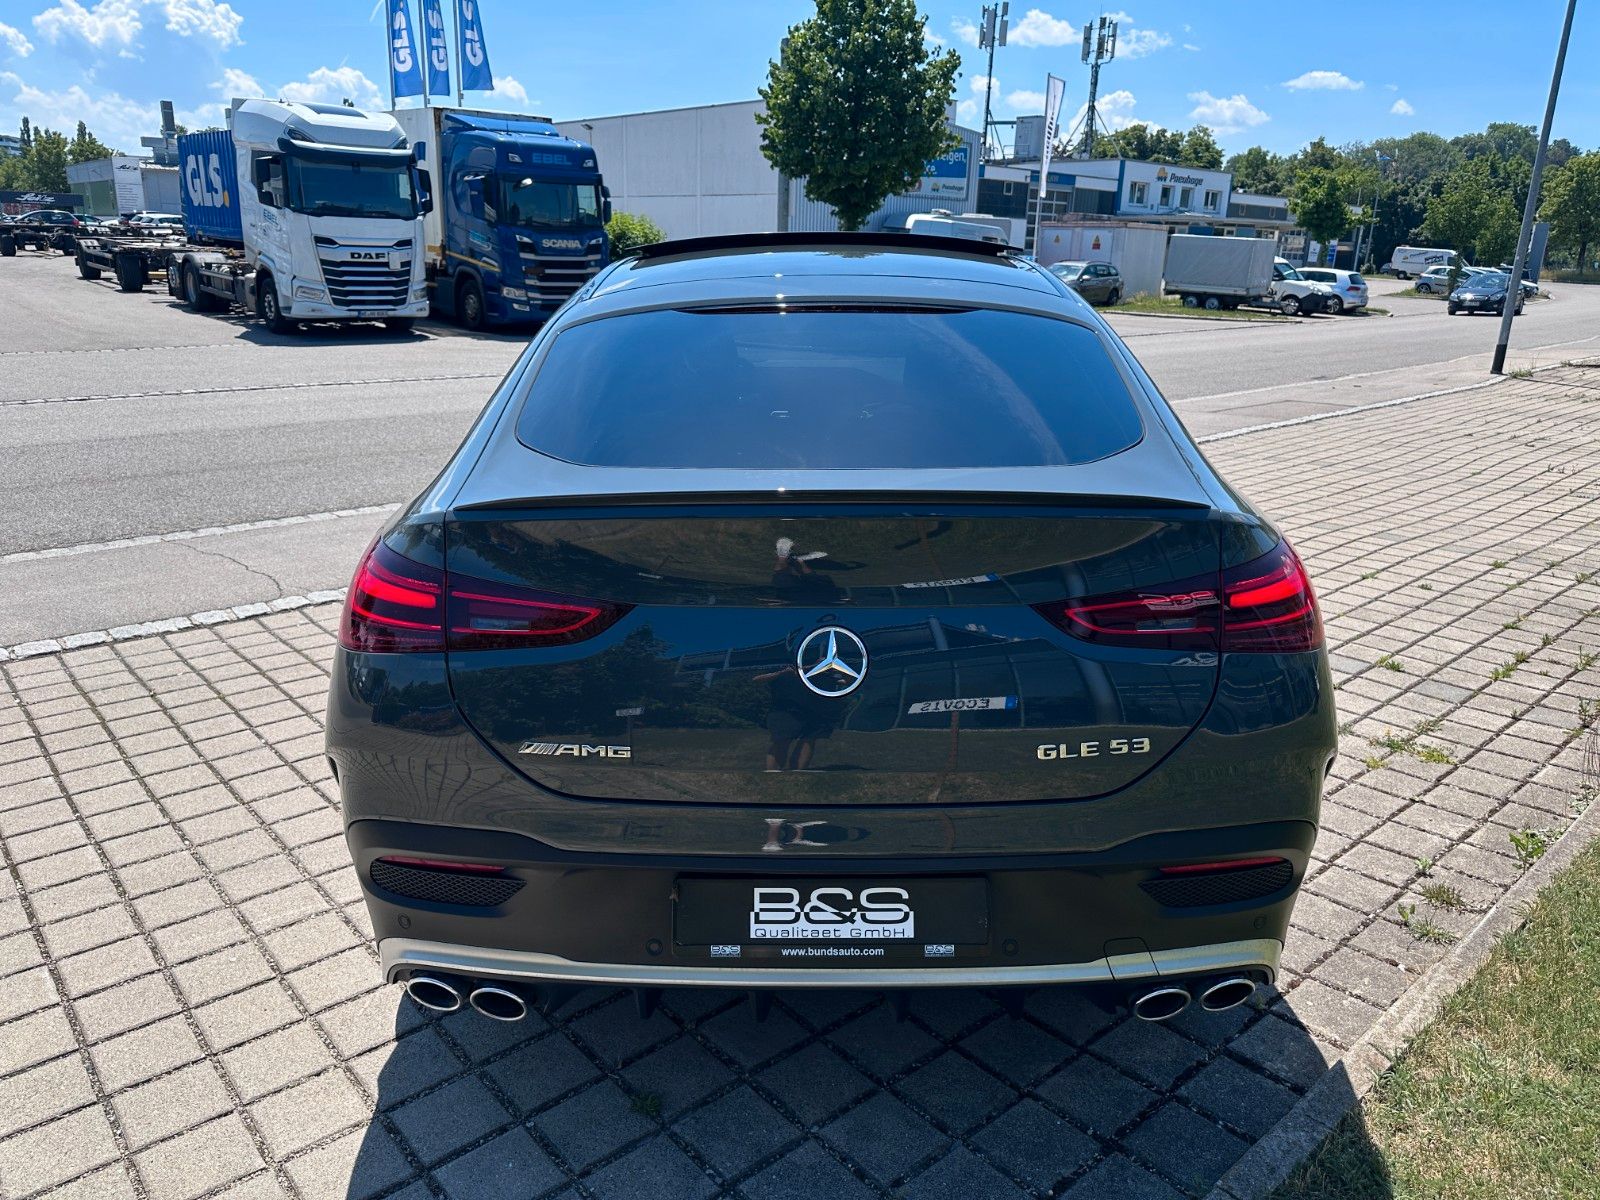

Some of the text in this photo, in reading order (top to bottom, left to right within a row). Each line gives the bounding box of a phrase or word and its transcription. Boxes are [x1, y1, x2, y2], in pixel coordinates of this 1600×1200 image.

[532, 152, 573, 166] EBEL
[542, 239, 581, 248] SCANIA
[350, 252, 386, 260] DAF
[553, 743, 632, 758] AMG
[1037, 737, 1151, 760] GLE 53
[753, 887, 910, 925] B&S
[754, 927, 842, 938] Qualitaet
[781, 947, 885, 957] www.bundsauto.com
